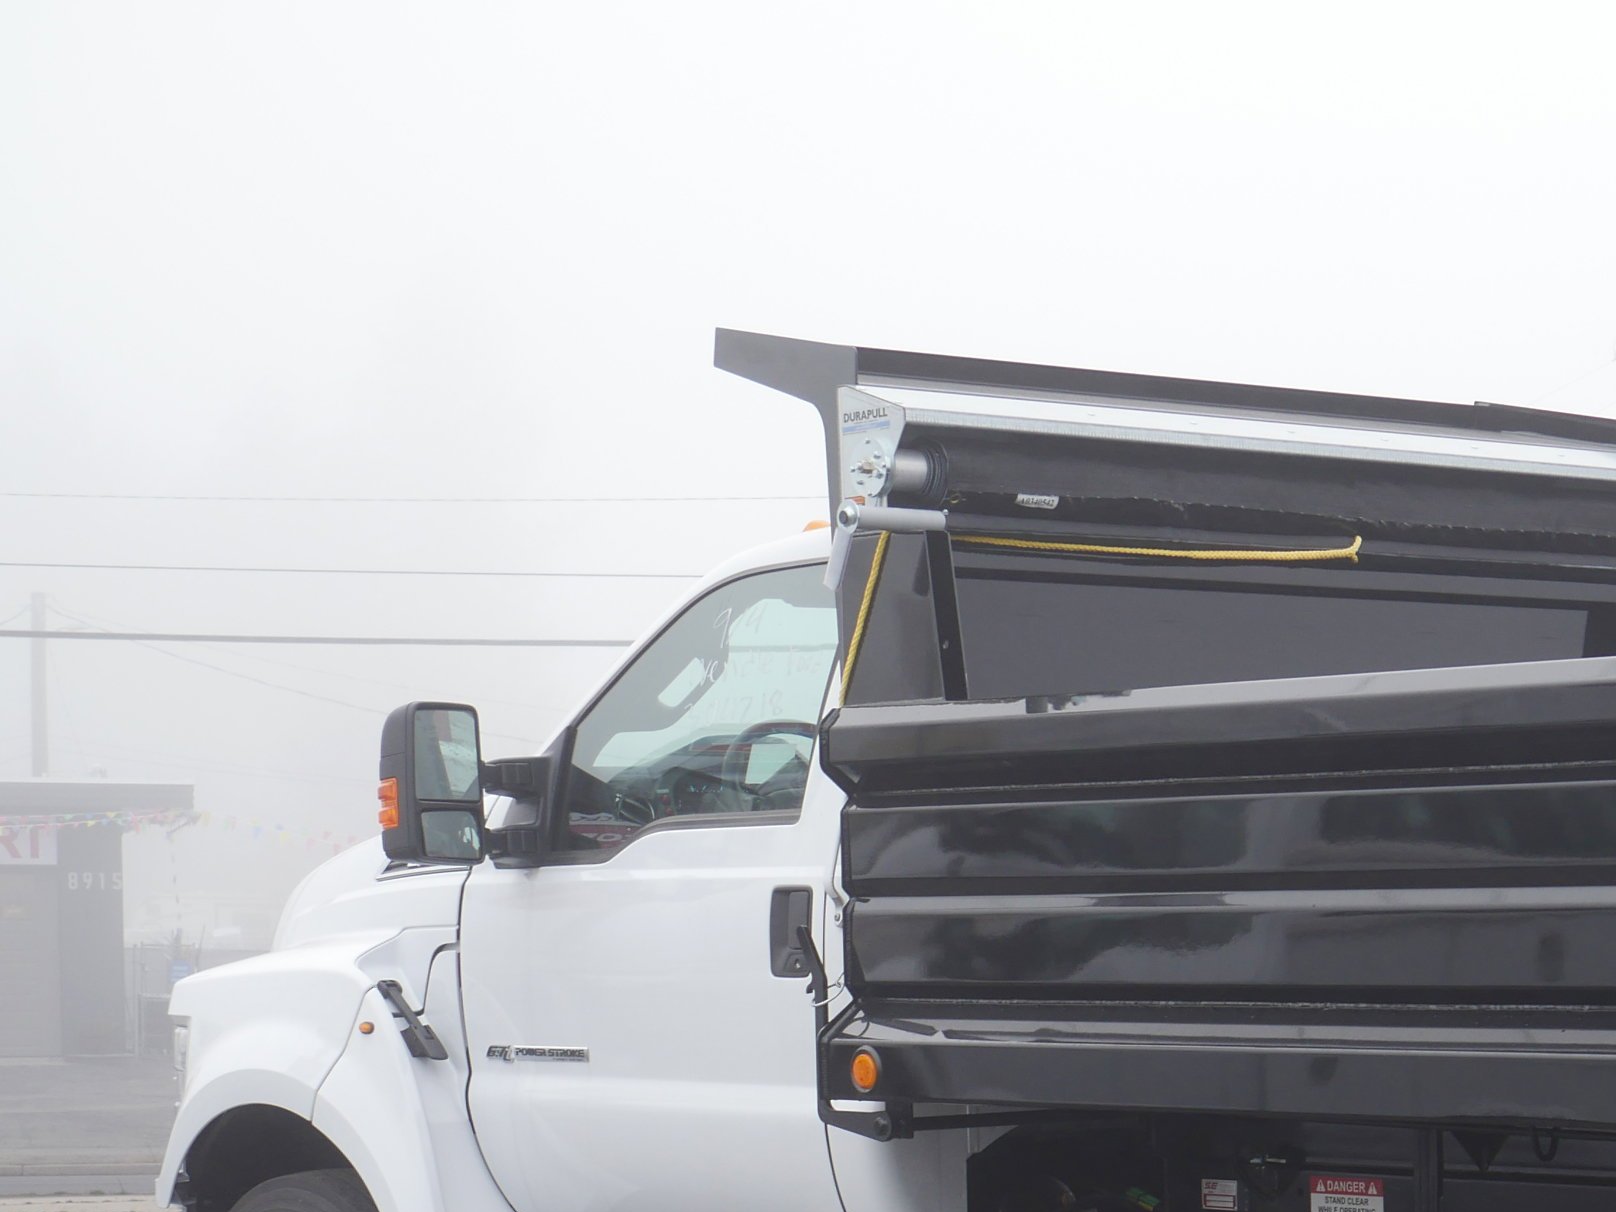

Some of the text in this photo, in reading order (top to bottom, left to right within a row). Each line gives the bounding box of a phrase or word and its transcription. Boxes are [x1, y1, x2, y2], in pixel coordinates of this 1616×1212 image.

[843, 407, 888, 423] DURAPULL
[67, 871, 123, 891] 8915
[548, 1048, 585, 1058] STROKE
[1326, 1180, 1366, 1193] DANGER
[1325, 1196, 1369, 1206] STAND CLEAR
